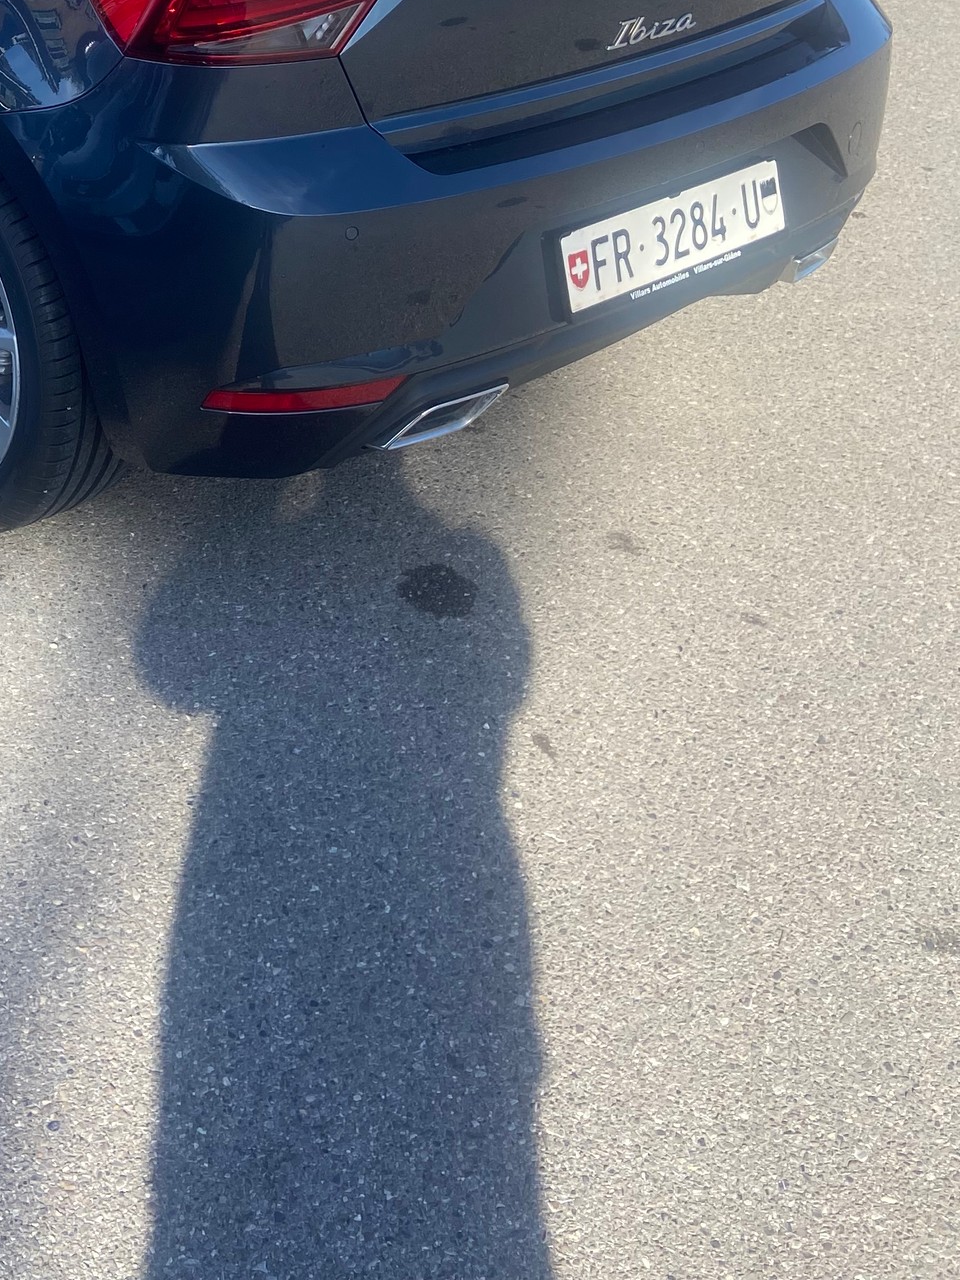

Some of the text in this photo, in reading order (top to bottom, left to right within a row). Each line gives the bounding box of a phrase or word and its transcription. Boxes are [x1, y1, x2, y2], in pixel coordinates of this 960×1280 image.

[606, 13, 697, 51] Ibiza
[590, 179, 761, 291] FR 3284 U
[630, 286, 651, 300] Villars
[652, 271, 690, 292] Automobiles
